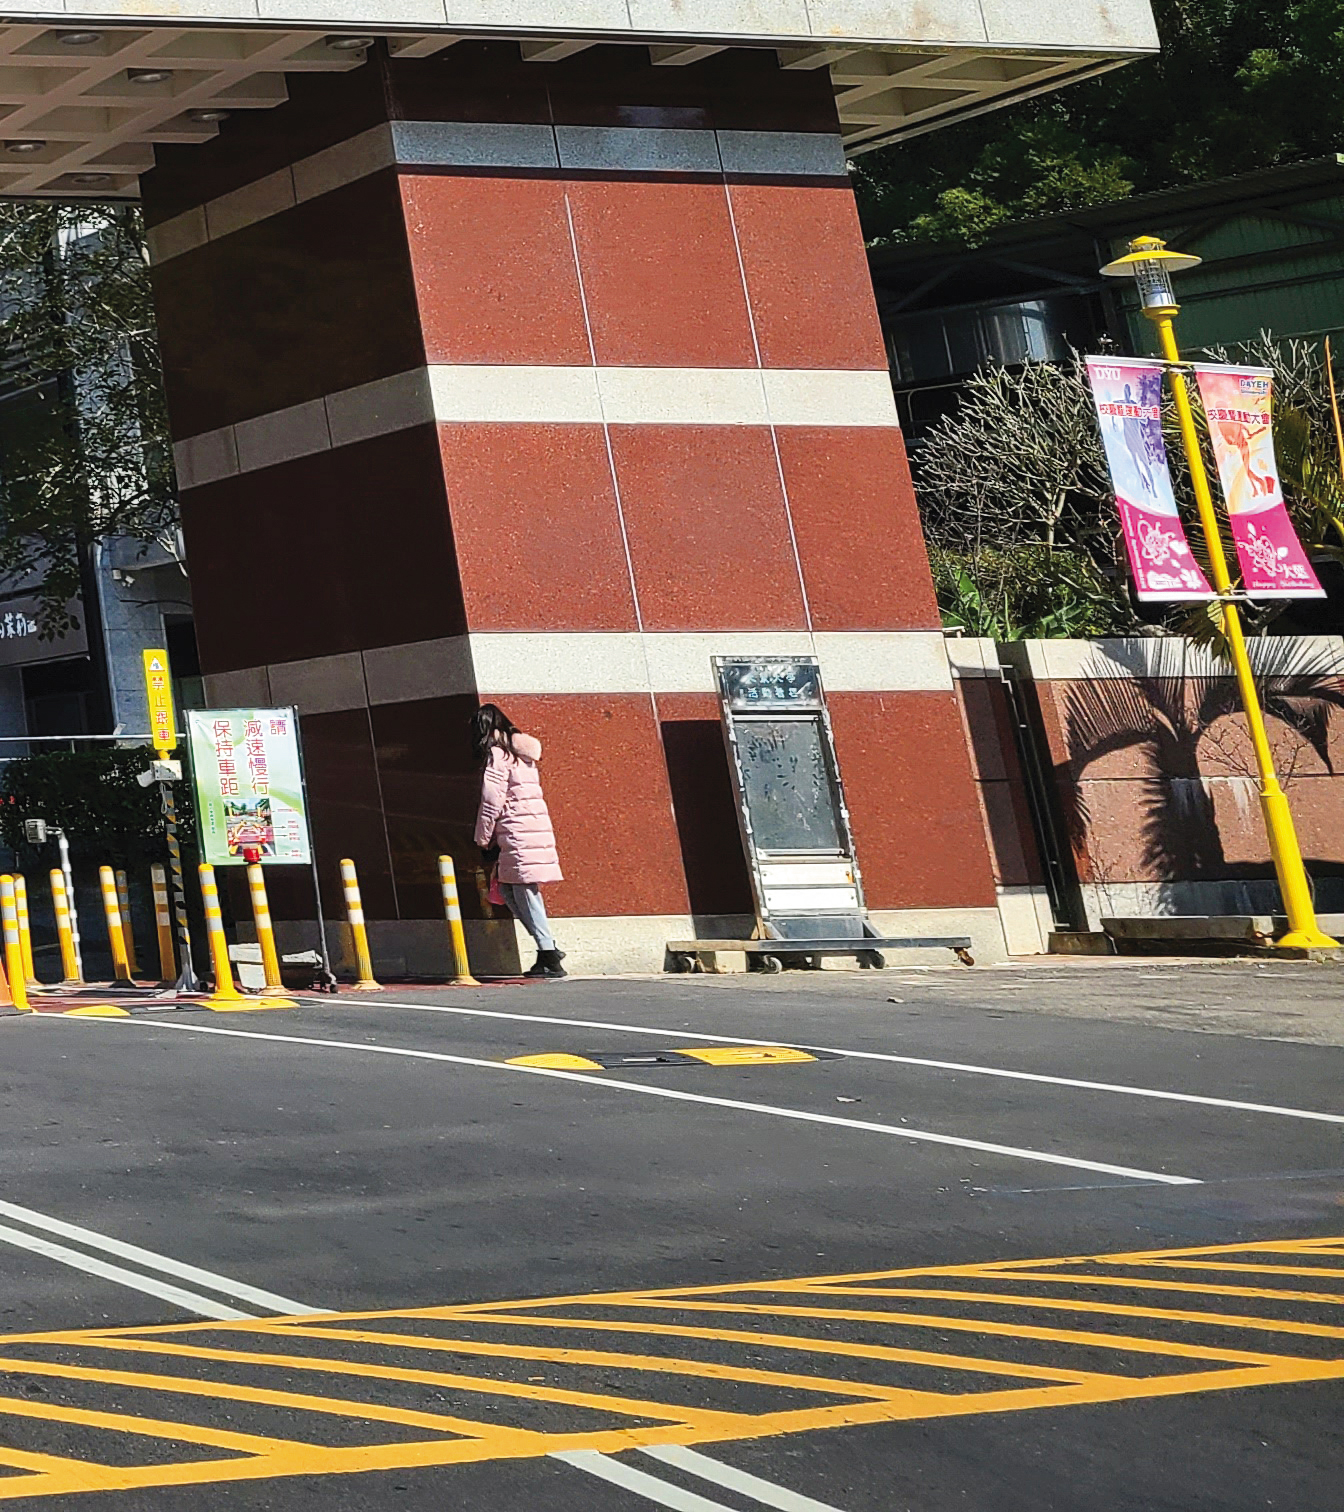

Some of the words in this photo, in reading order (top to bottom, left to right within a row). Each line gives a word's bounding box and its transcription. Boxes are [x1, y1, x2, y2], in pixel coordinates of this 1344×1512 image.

[1094, 367, 1121, 381] DYU
[1240, 379, 1269, 388] DAYEH
[269, 719, 287, 736] 請
[213, 719, 240, 796] 保持車距
[243, 719, 270, 796] 減速慢行
